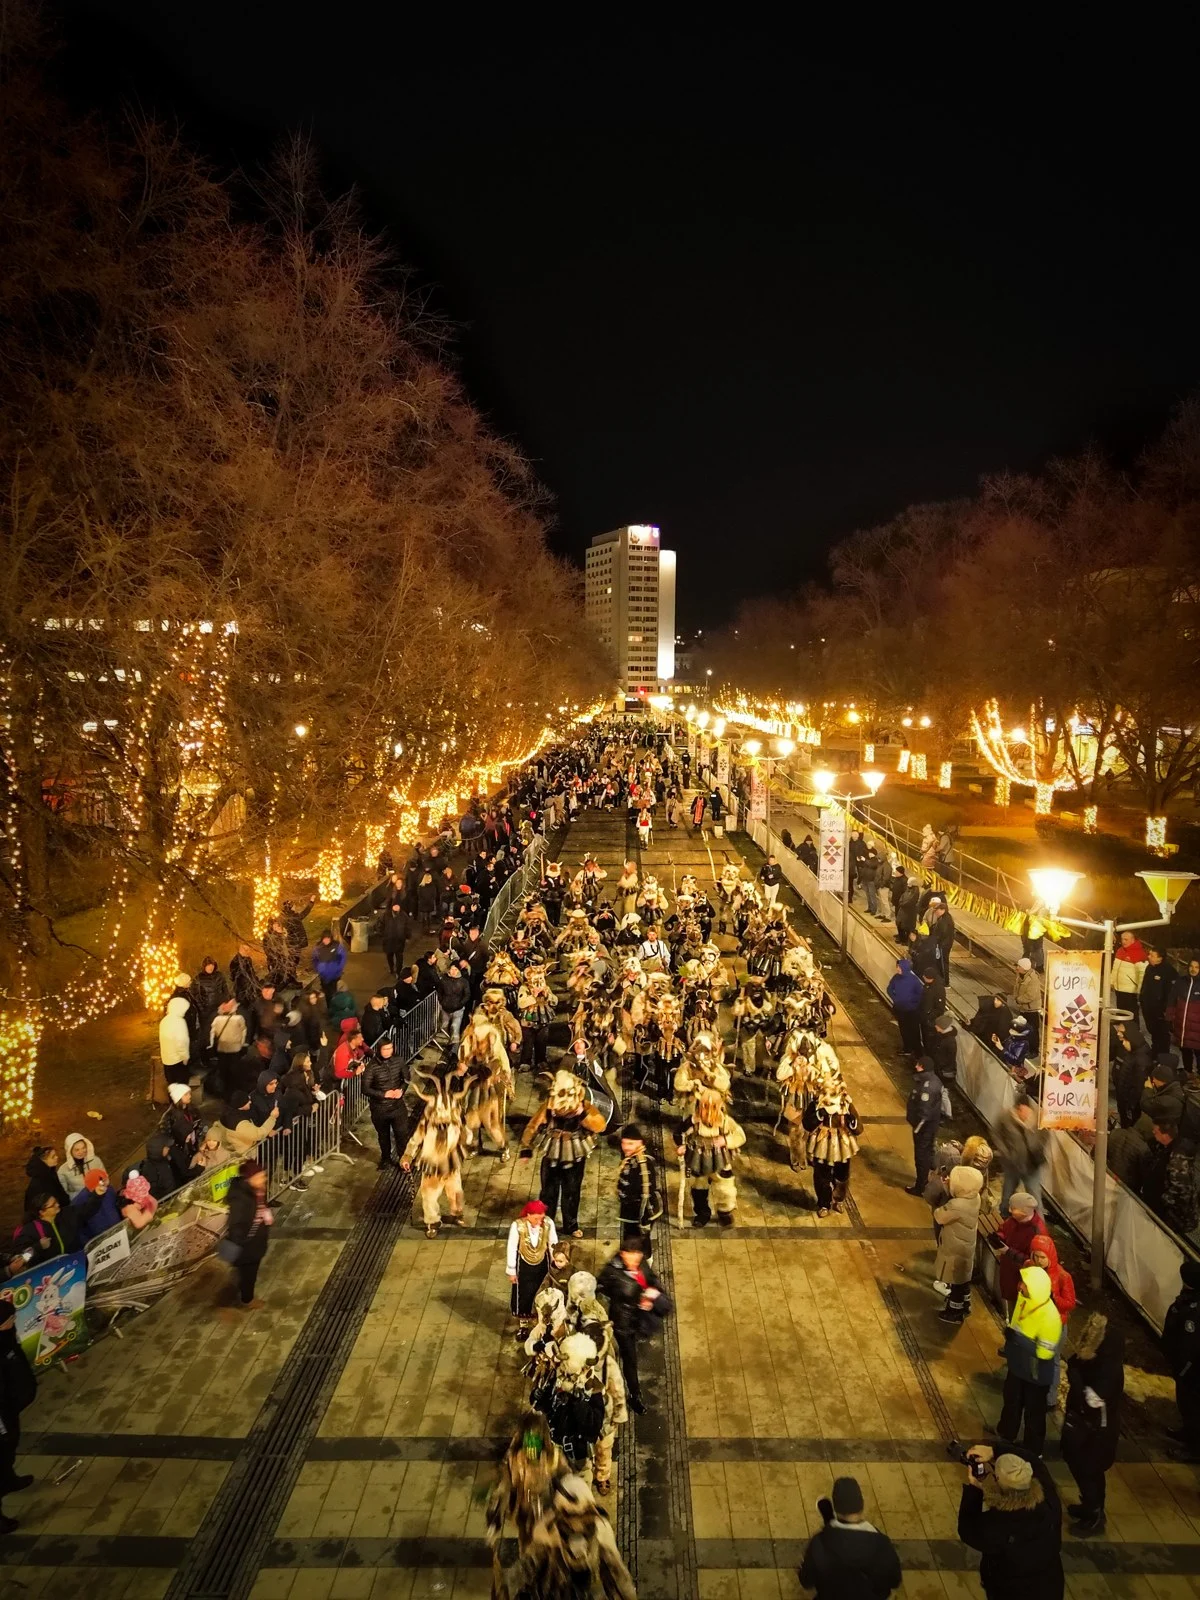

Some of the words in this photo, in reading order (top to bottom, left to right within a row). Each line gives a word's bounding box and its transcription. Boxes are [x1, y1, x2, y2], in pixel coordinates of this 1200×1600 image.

[1053, 975, 1096, 991] СУРВА
[1046, 1092, 1091, 1108] SURVA
[94, 1252, 111, 1264] ARK
